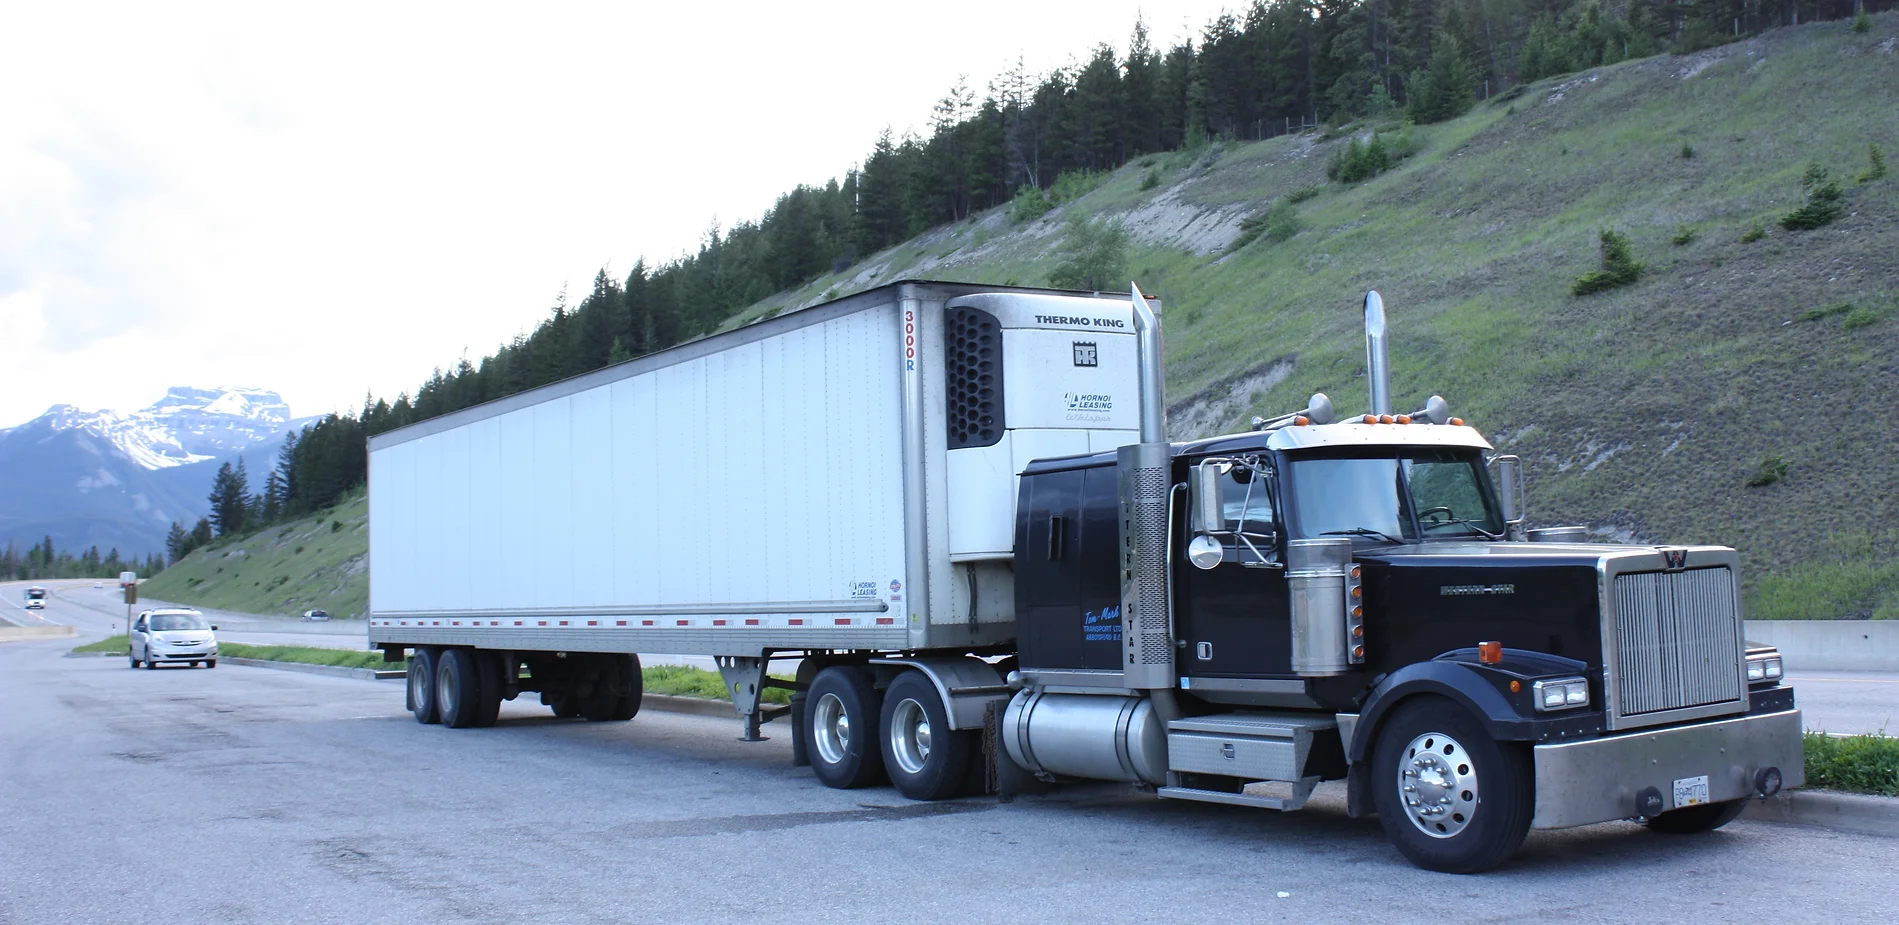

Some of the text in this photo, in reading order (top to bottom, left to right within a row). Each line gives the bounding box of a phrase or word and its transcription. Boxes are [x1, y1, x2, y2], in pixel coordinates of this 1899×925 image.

[1035, 315, 1124, 328] THERMO KING
[905, 310, 915, 371] 3000R
[1080, 394, 1112, 402] HORNOI
